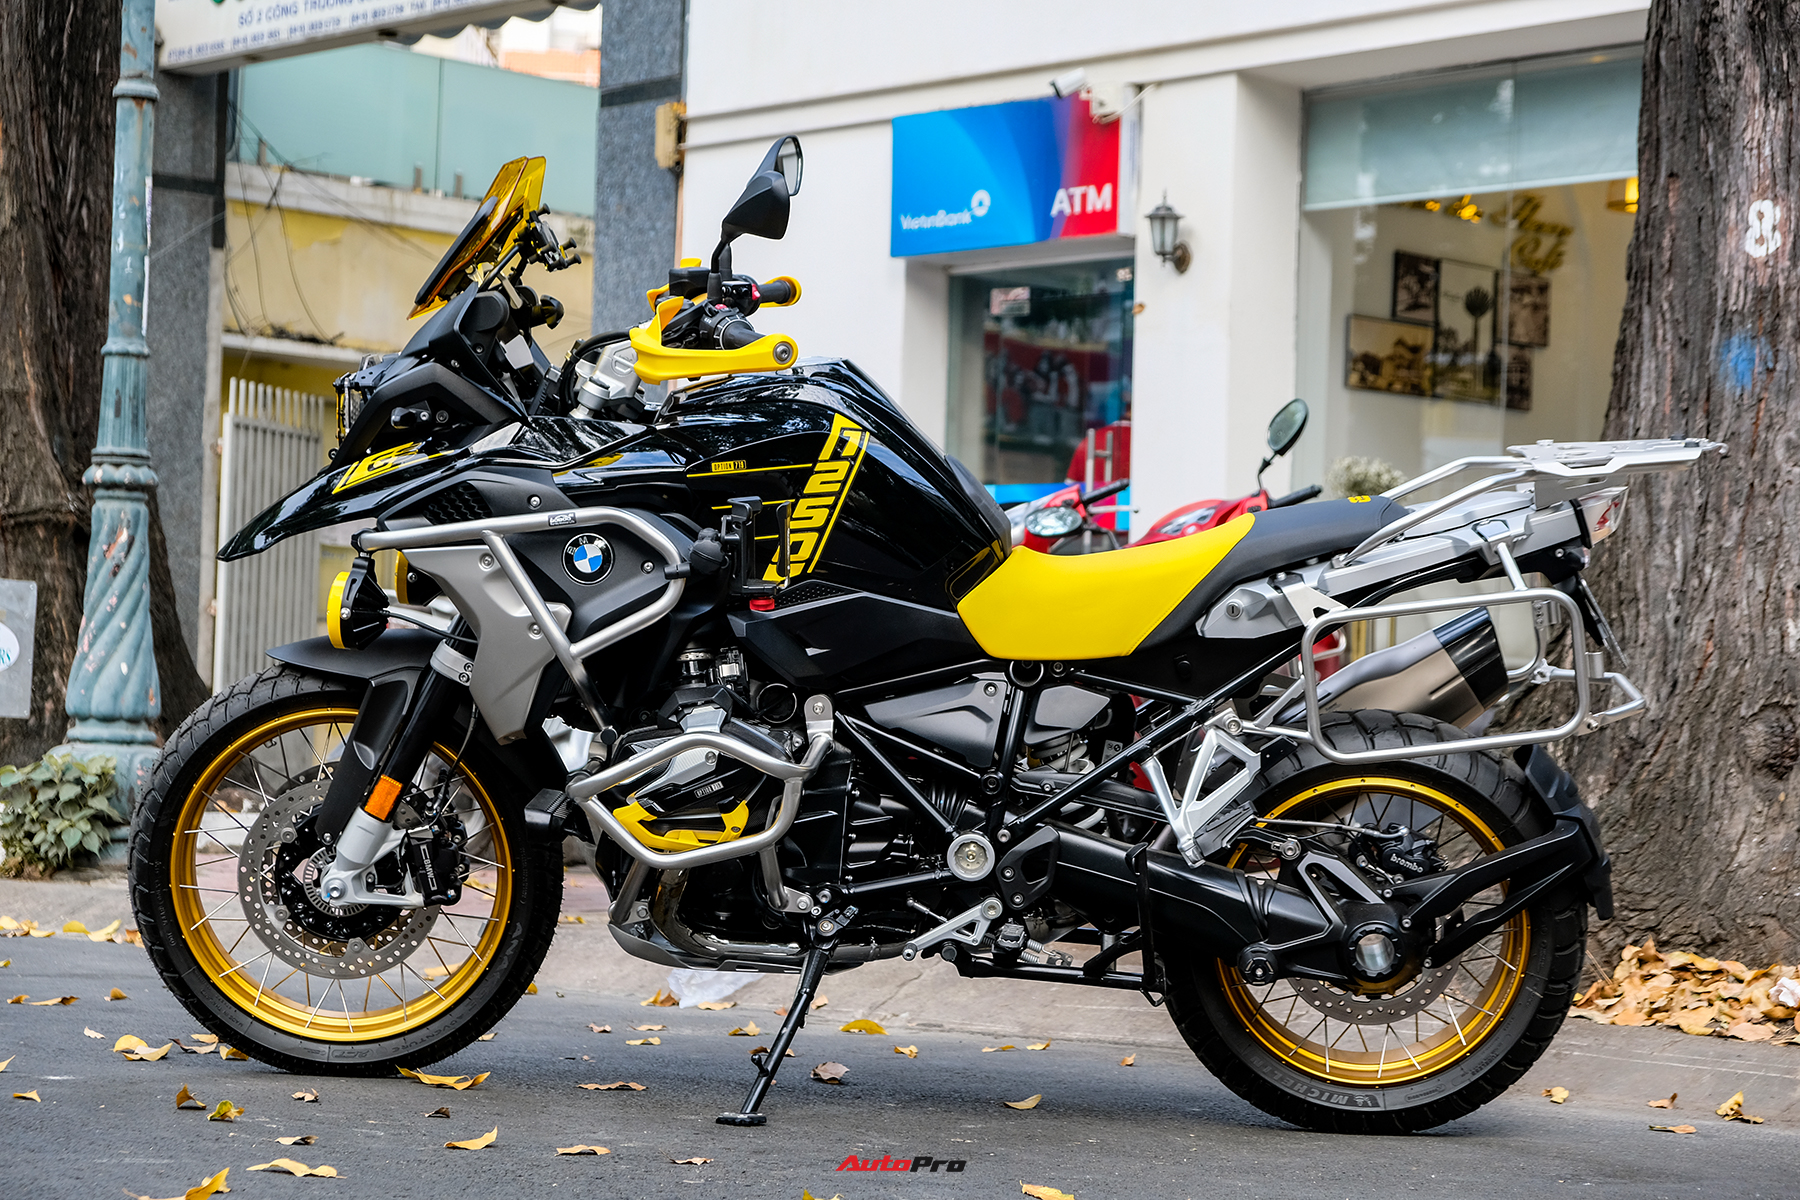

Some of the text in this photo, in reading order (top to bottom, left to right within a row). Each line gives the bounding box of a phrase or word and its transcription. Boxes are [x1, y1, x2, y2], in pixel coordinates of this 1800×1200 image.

[1050, 183, 1113, 218] ATM
[1745, 199, 1781, 258] 8
[566, 535, 607, 556] BMW
[423, 859, 435, 878] BMW
[1390, 853, 1424, 873] brembo
[1250, 1054, 1350, 1106] MICHELIN
